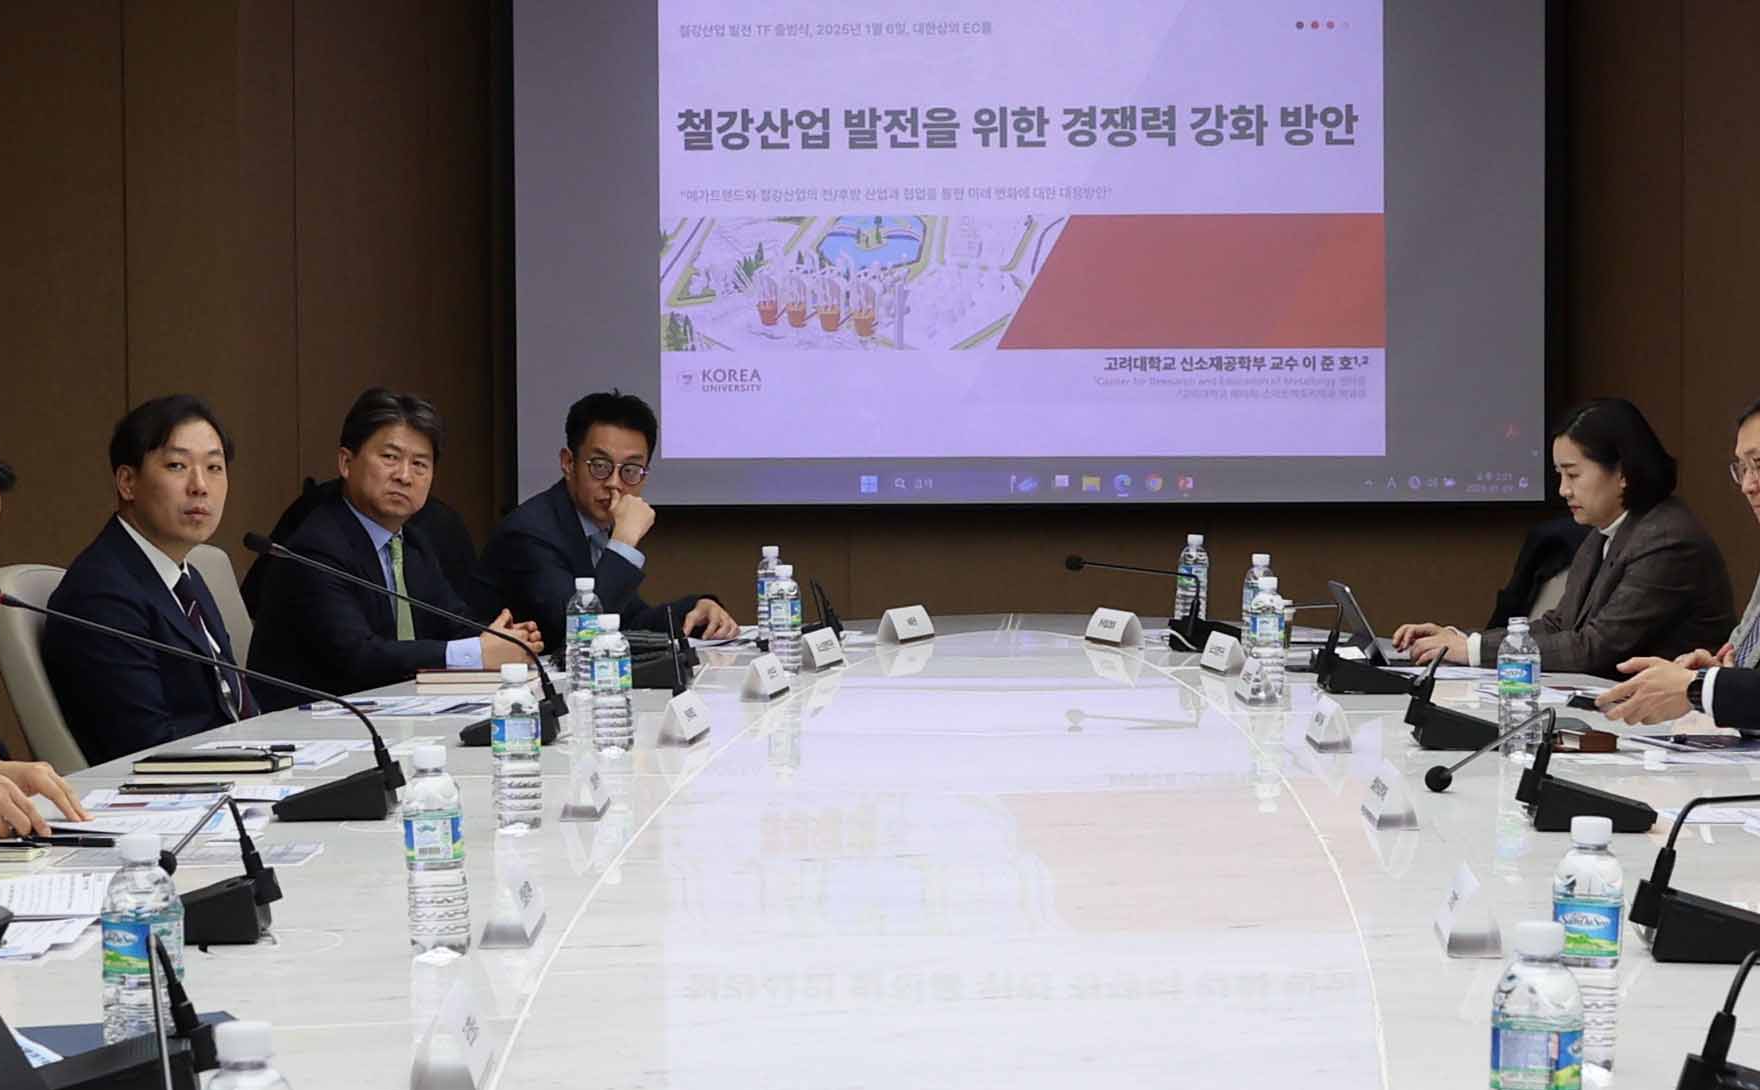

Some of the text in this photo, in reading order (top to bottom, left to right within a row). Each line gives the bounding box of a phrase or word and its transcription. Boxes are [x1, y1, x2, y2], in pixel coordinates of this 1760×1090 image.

[756, 24, 773, 37] TF
[677, 103, 1360, 151] 철강산업 발전을 위한 경쟁력 강화 방안
[1103, 355, 1177, 373] 고려대학교
[1180, 355, 1267, 373] 신소재공학부
[1269, 355, 1300, 373] 교수
[1302, 355, 1317, 373] 이
[1320, 355, 1336, 372] 준
[701, 368, 762, 383] KOREA
[701, 383, 762, 393] UNIVERSITY
